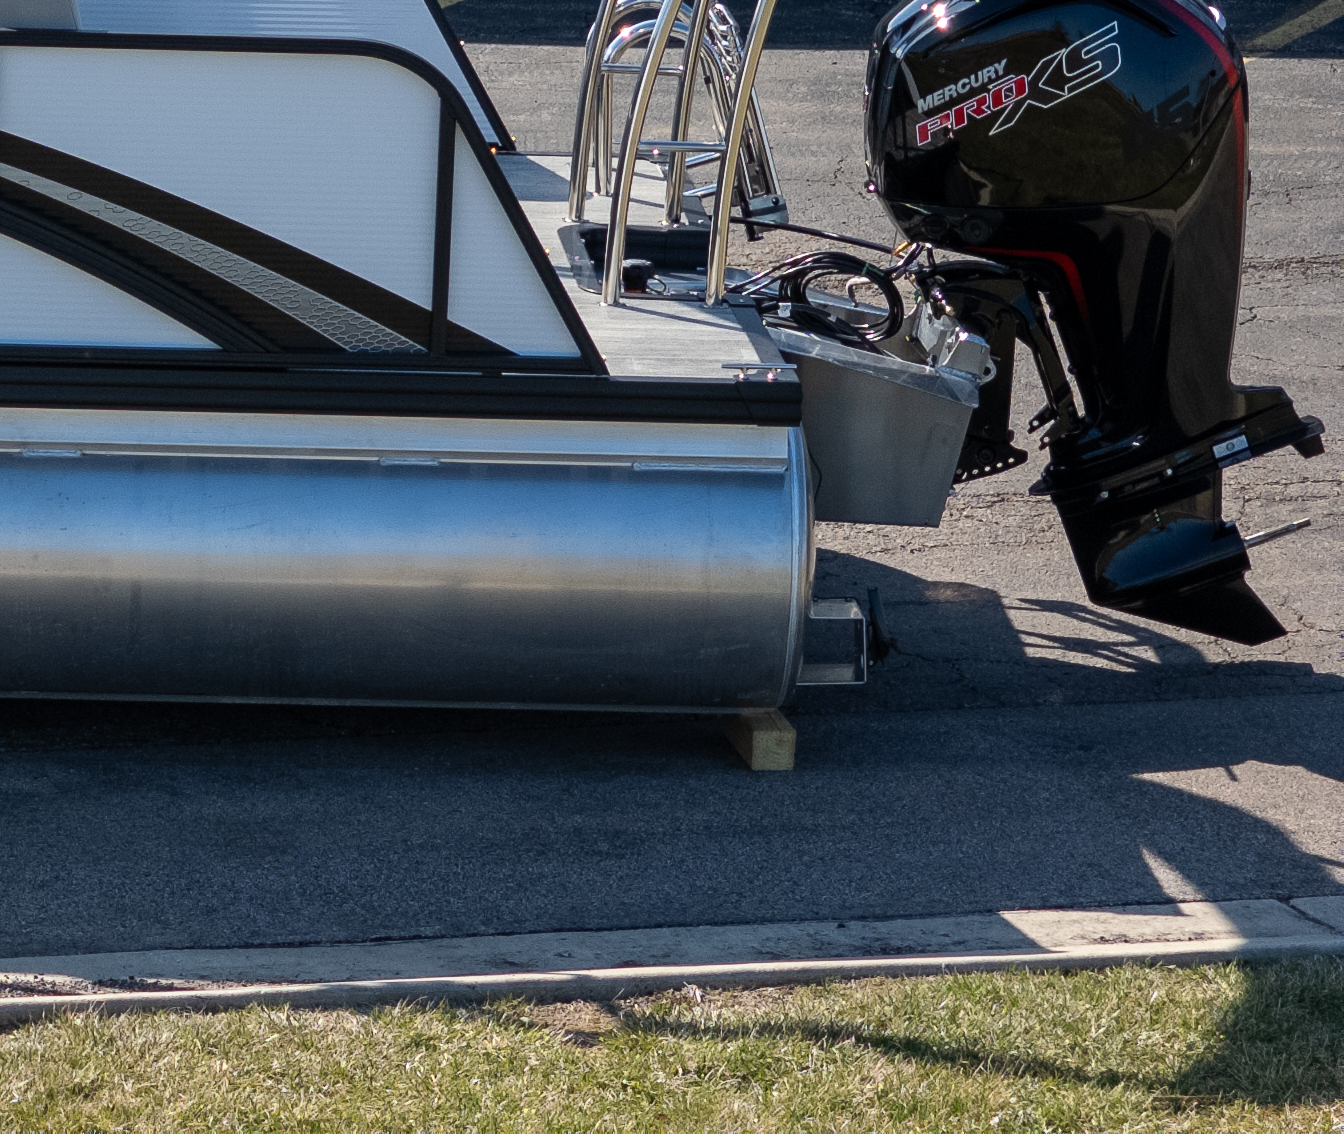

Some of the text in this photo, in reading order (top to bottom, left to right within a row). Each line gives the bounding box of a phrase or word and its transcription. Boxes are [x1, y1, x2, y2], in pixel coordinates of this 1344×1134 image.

[916, 75, 1028, 146] PRO
[989, 21, 1121, 136] XS
[917, 58, 1007, 114] MERCURY
